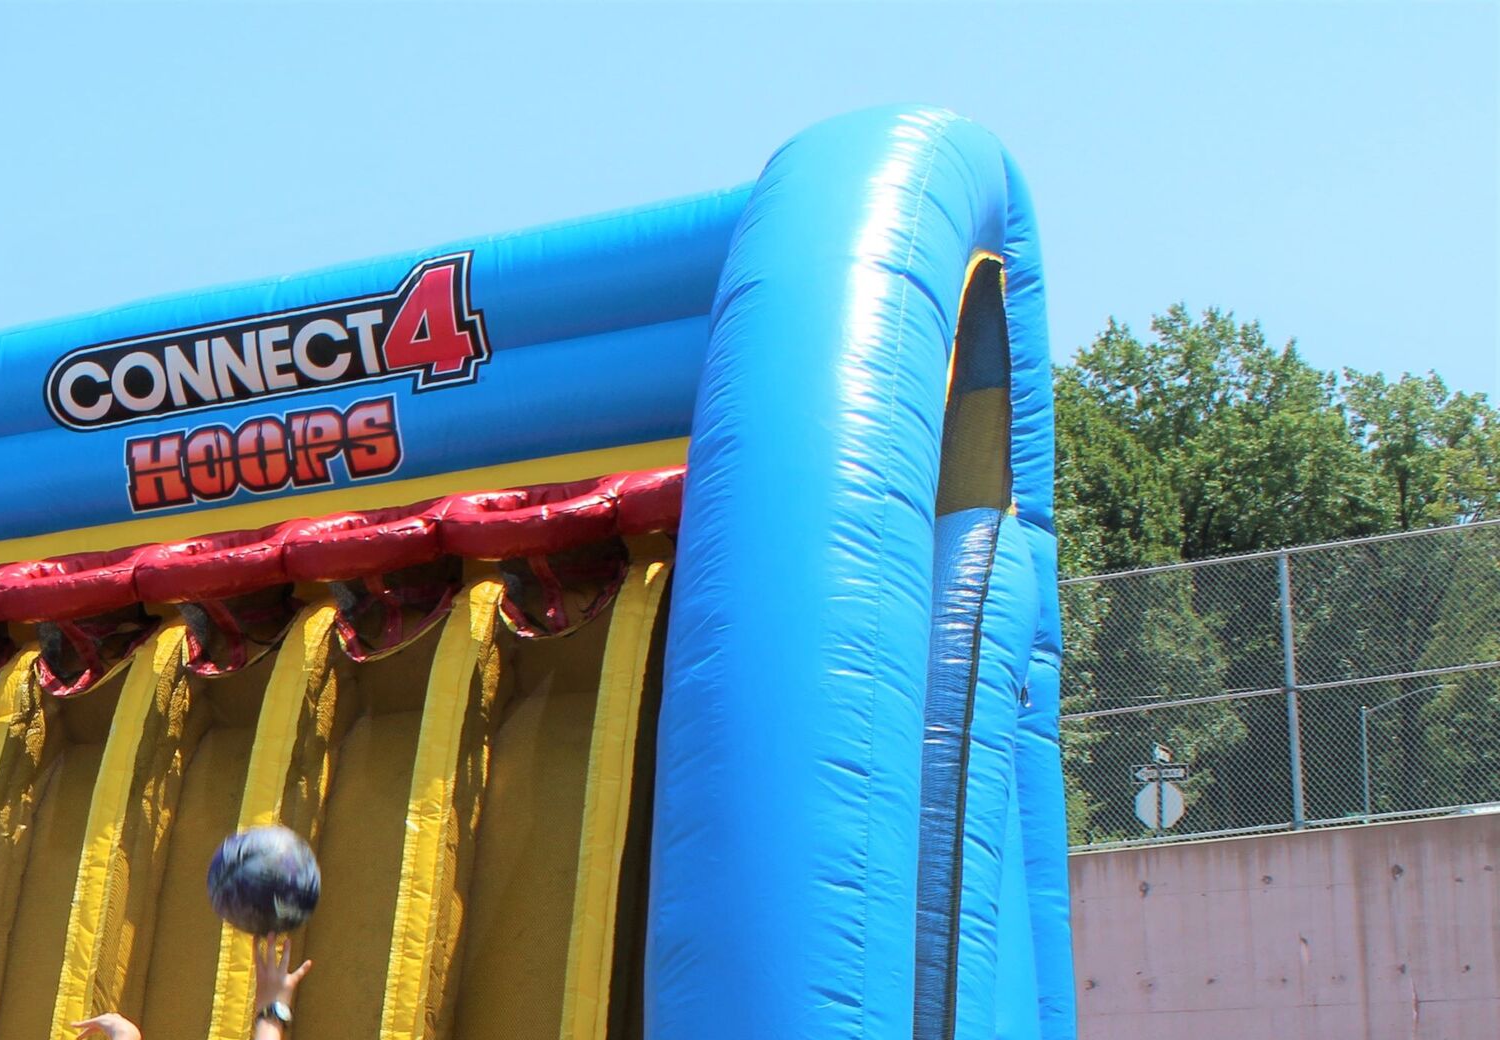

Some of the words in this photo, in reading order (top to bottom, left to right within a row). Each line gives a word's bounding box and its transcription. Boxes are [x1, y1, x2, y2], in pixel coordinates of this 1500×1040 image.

[57, 308, 385, 422] CONNECT
[381, 262, 476, 376] 4
[129, 397, 402, 510] HOOPS
